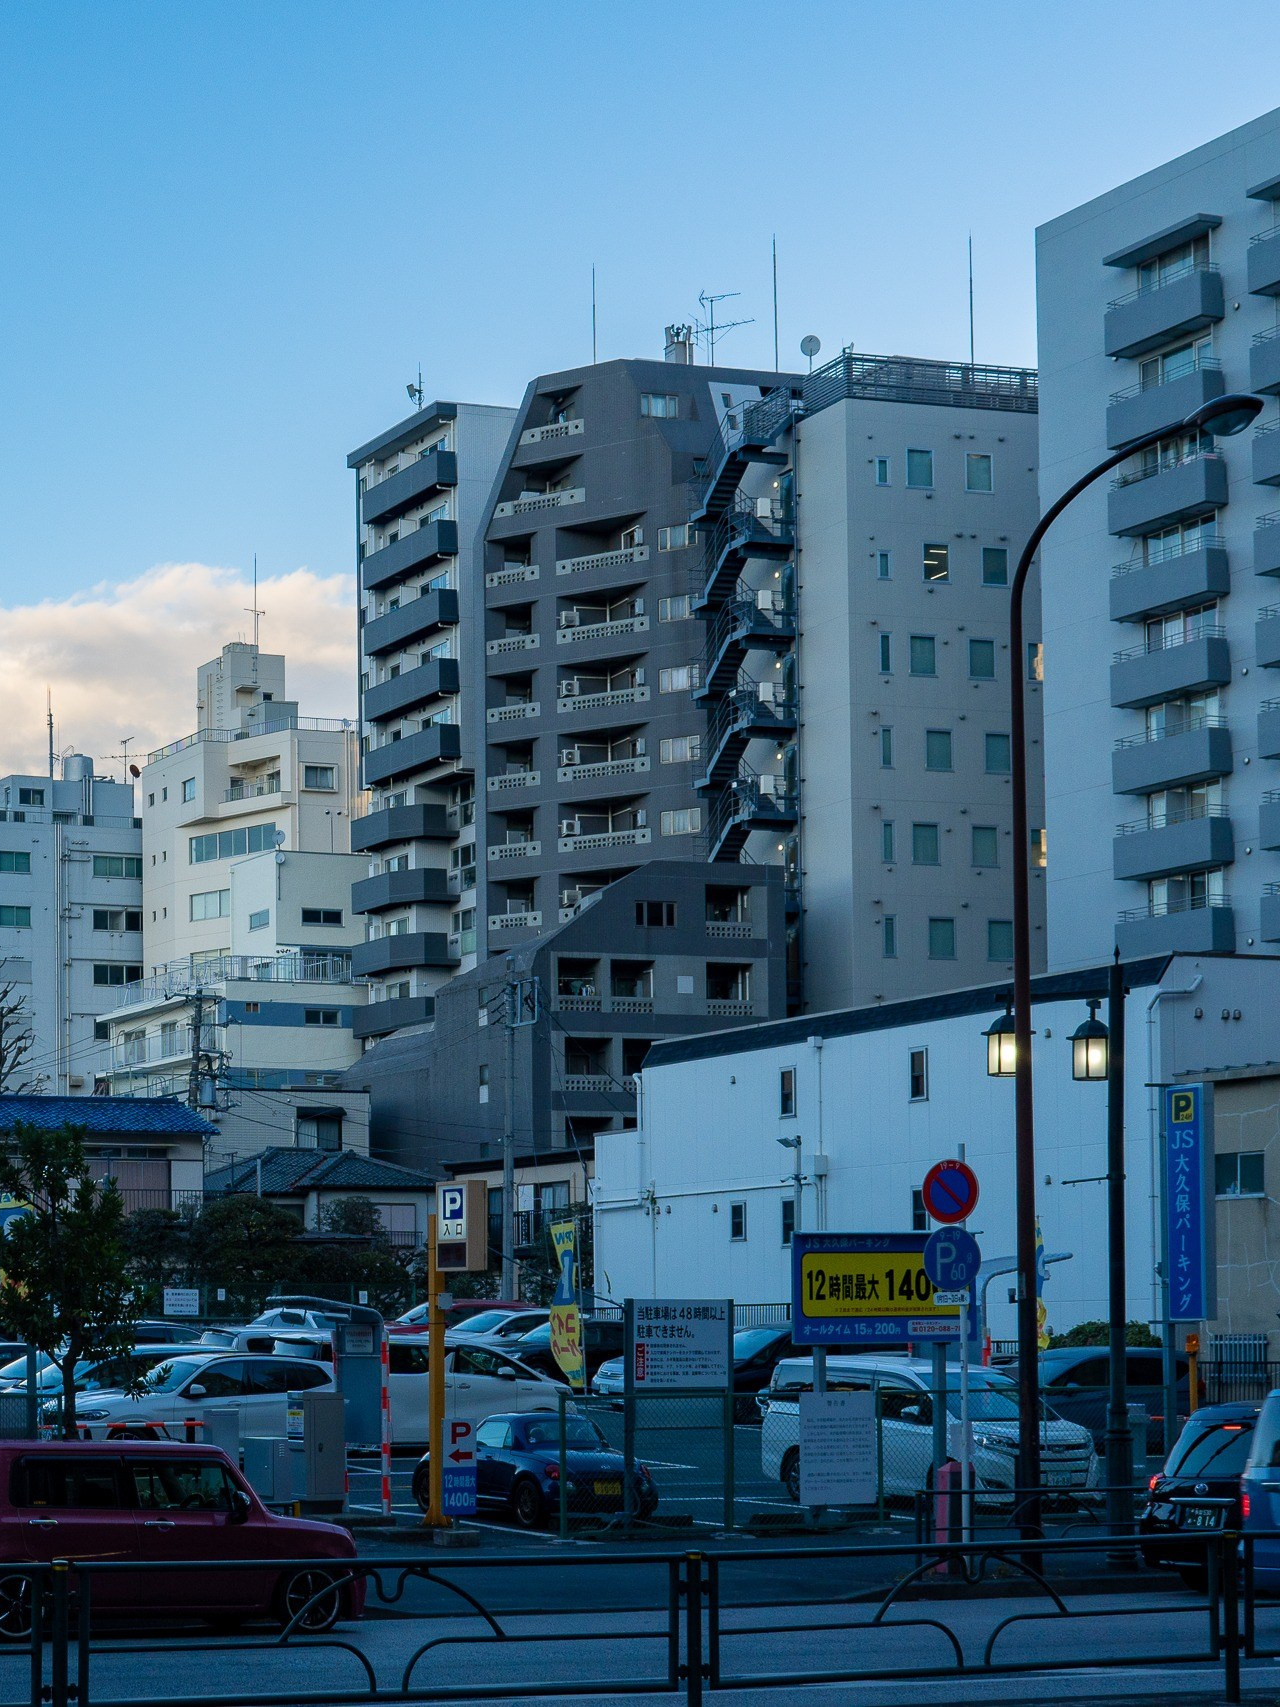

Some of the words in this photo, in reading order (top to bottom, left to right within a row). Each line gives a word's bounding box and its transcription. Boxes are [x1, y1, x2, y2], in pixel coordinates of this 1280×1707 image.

[1174, 1094, 1192, 1121] P
[1172, 1129, 1194, 1149] JS
[445, 1191, 462, 1218] P
[443, 1223, 462, 1236] 入口
[1174, 1154, 1191, 1312] 大久保パーキング
[805, 1238, 820, 1249] JS
[936, 1242, 957, 1281] P
[637, 1324, 695, 1339] 駐車できません。
[803, 1324, 851, 1335] オールタイム
[854, 1323, 873, 1335] 15分
[874, 1323, 901, 1335] 200円
[451, 1422, 471, 1445] P
[444, 1474, 476, 1488] 12時間最大
[444, 1492, 476, 1507] 1400円
